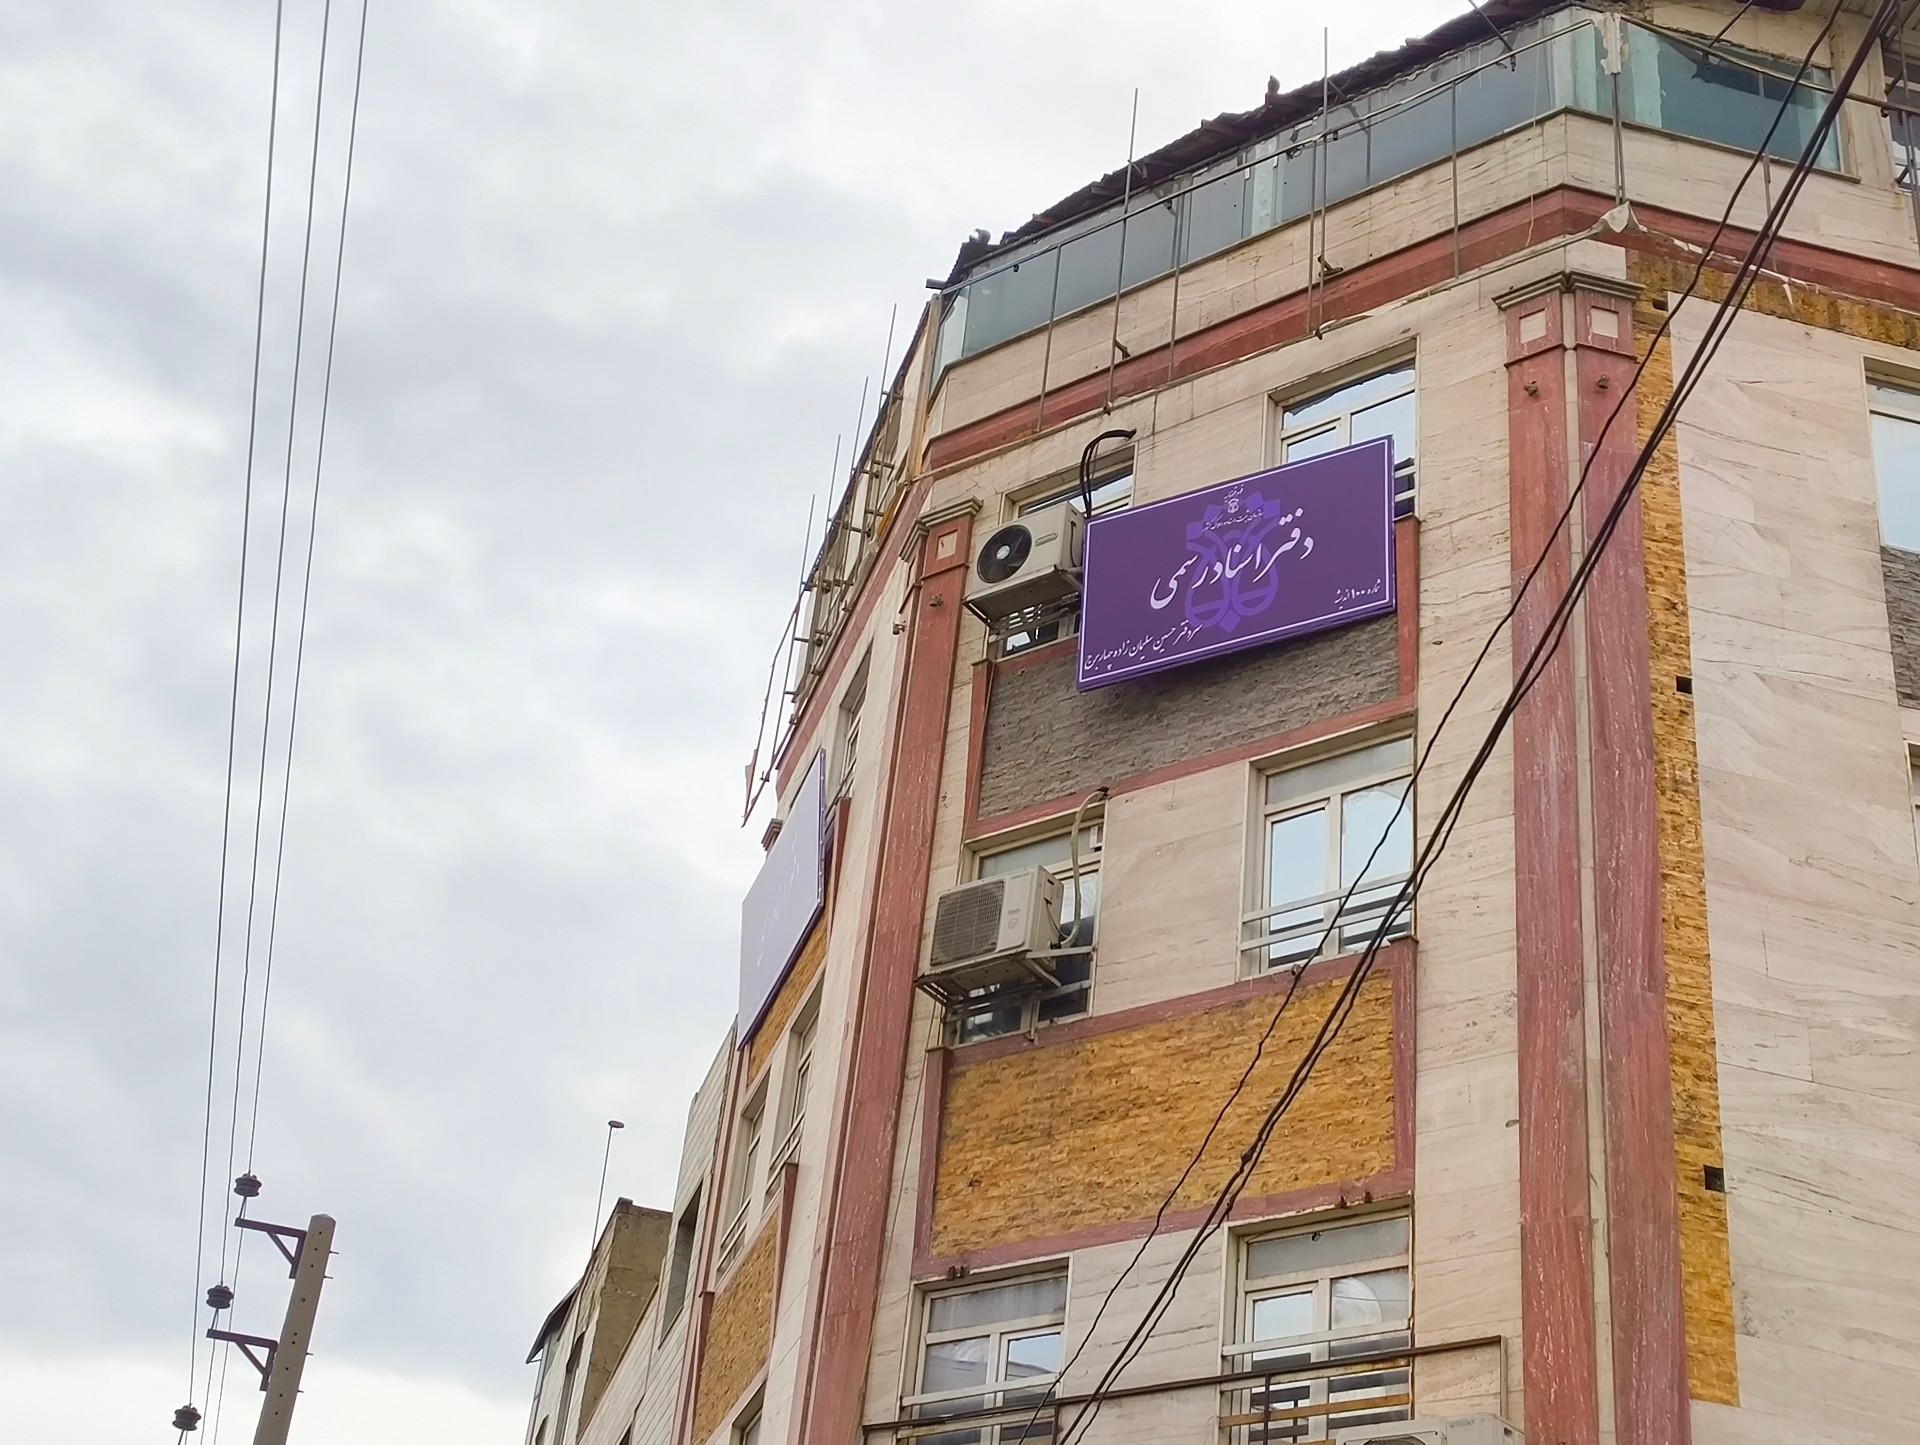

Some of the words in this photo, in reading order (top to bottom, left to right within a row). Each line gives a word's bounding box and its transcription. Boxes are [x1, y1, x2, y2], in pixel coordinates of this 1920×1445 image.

[1210, 542, 1263, 585] اسناد
[1253, 507, 1314, 583] دفتر
[1150, 555, 1209, 610] رسمی
[1152, 627, 1177, 653] حسین
